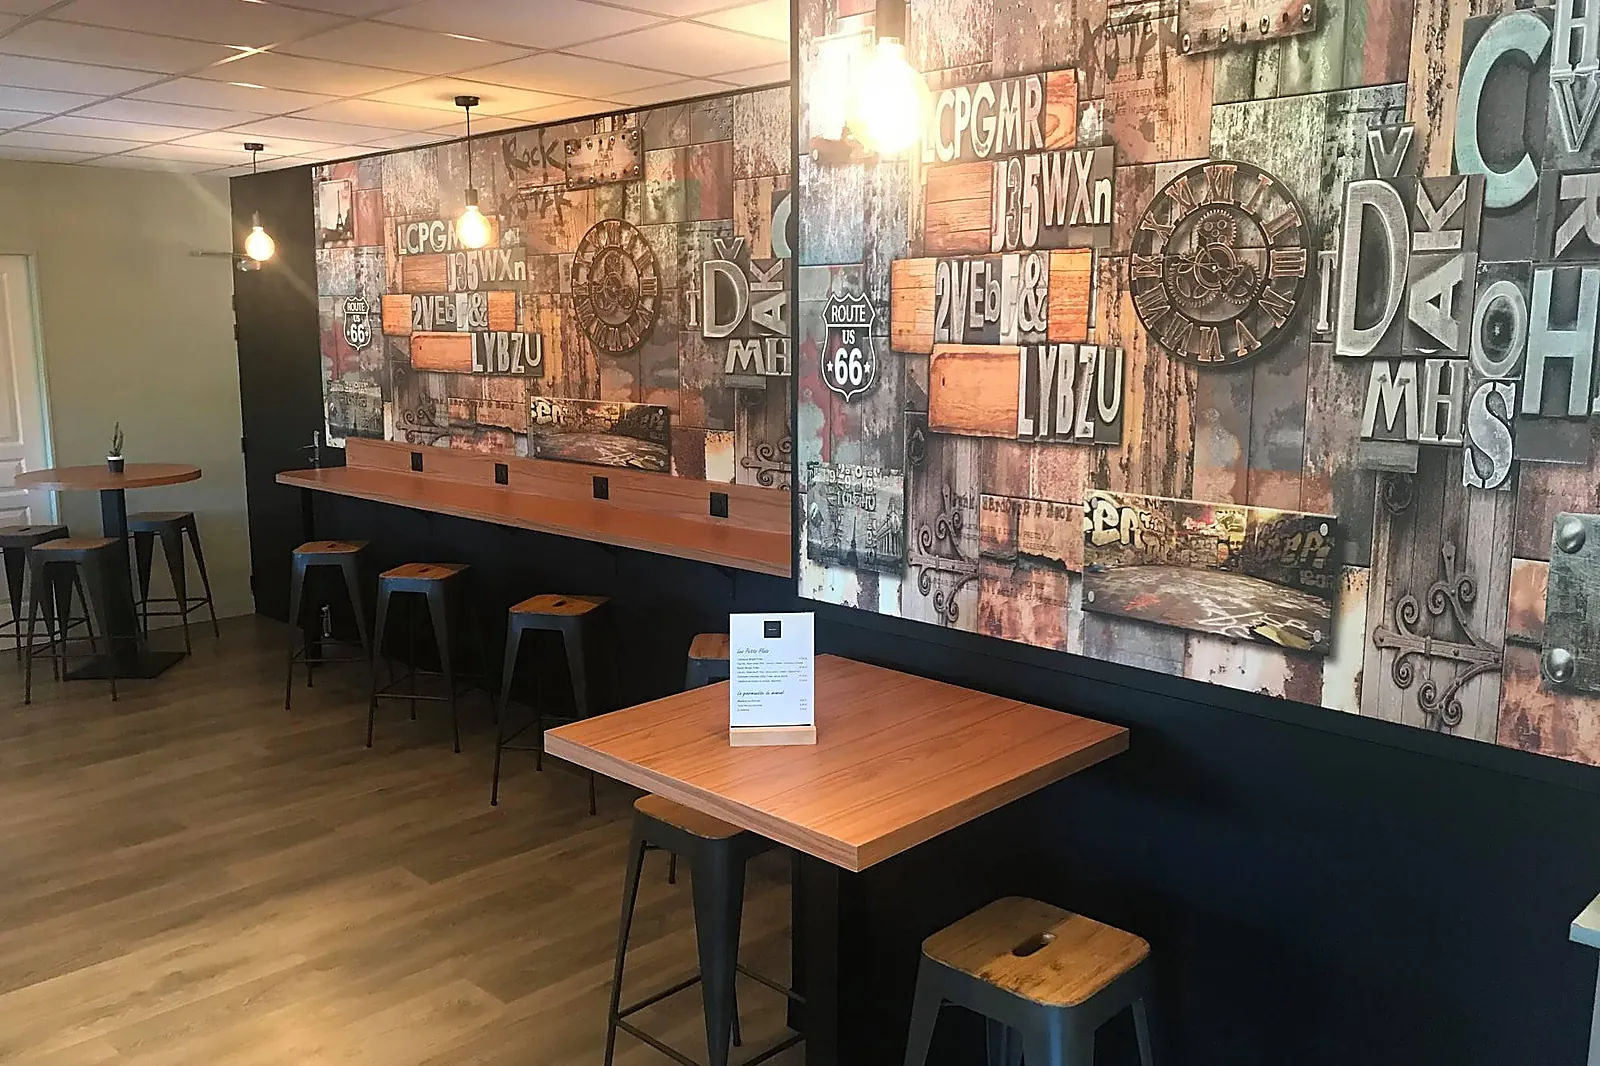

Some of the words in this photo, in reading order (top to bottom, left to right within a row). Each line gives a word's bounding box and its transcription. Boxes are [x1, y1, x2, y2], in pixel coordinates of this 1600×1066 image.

[346, 302, 366, 312] ROUTE
[832, 304, 866, 322] ROUTE
[351, 323, 365, 342] 66
[842, 329, 856, 345] US
[472, 332, 542, 374] LYBZU
[834, 347, 863, 386] 66
[1018, 344, 1124, 438] LYBZU
